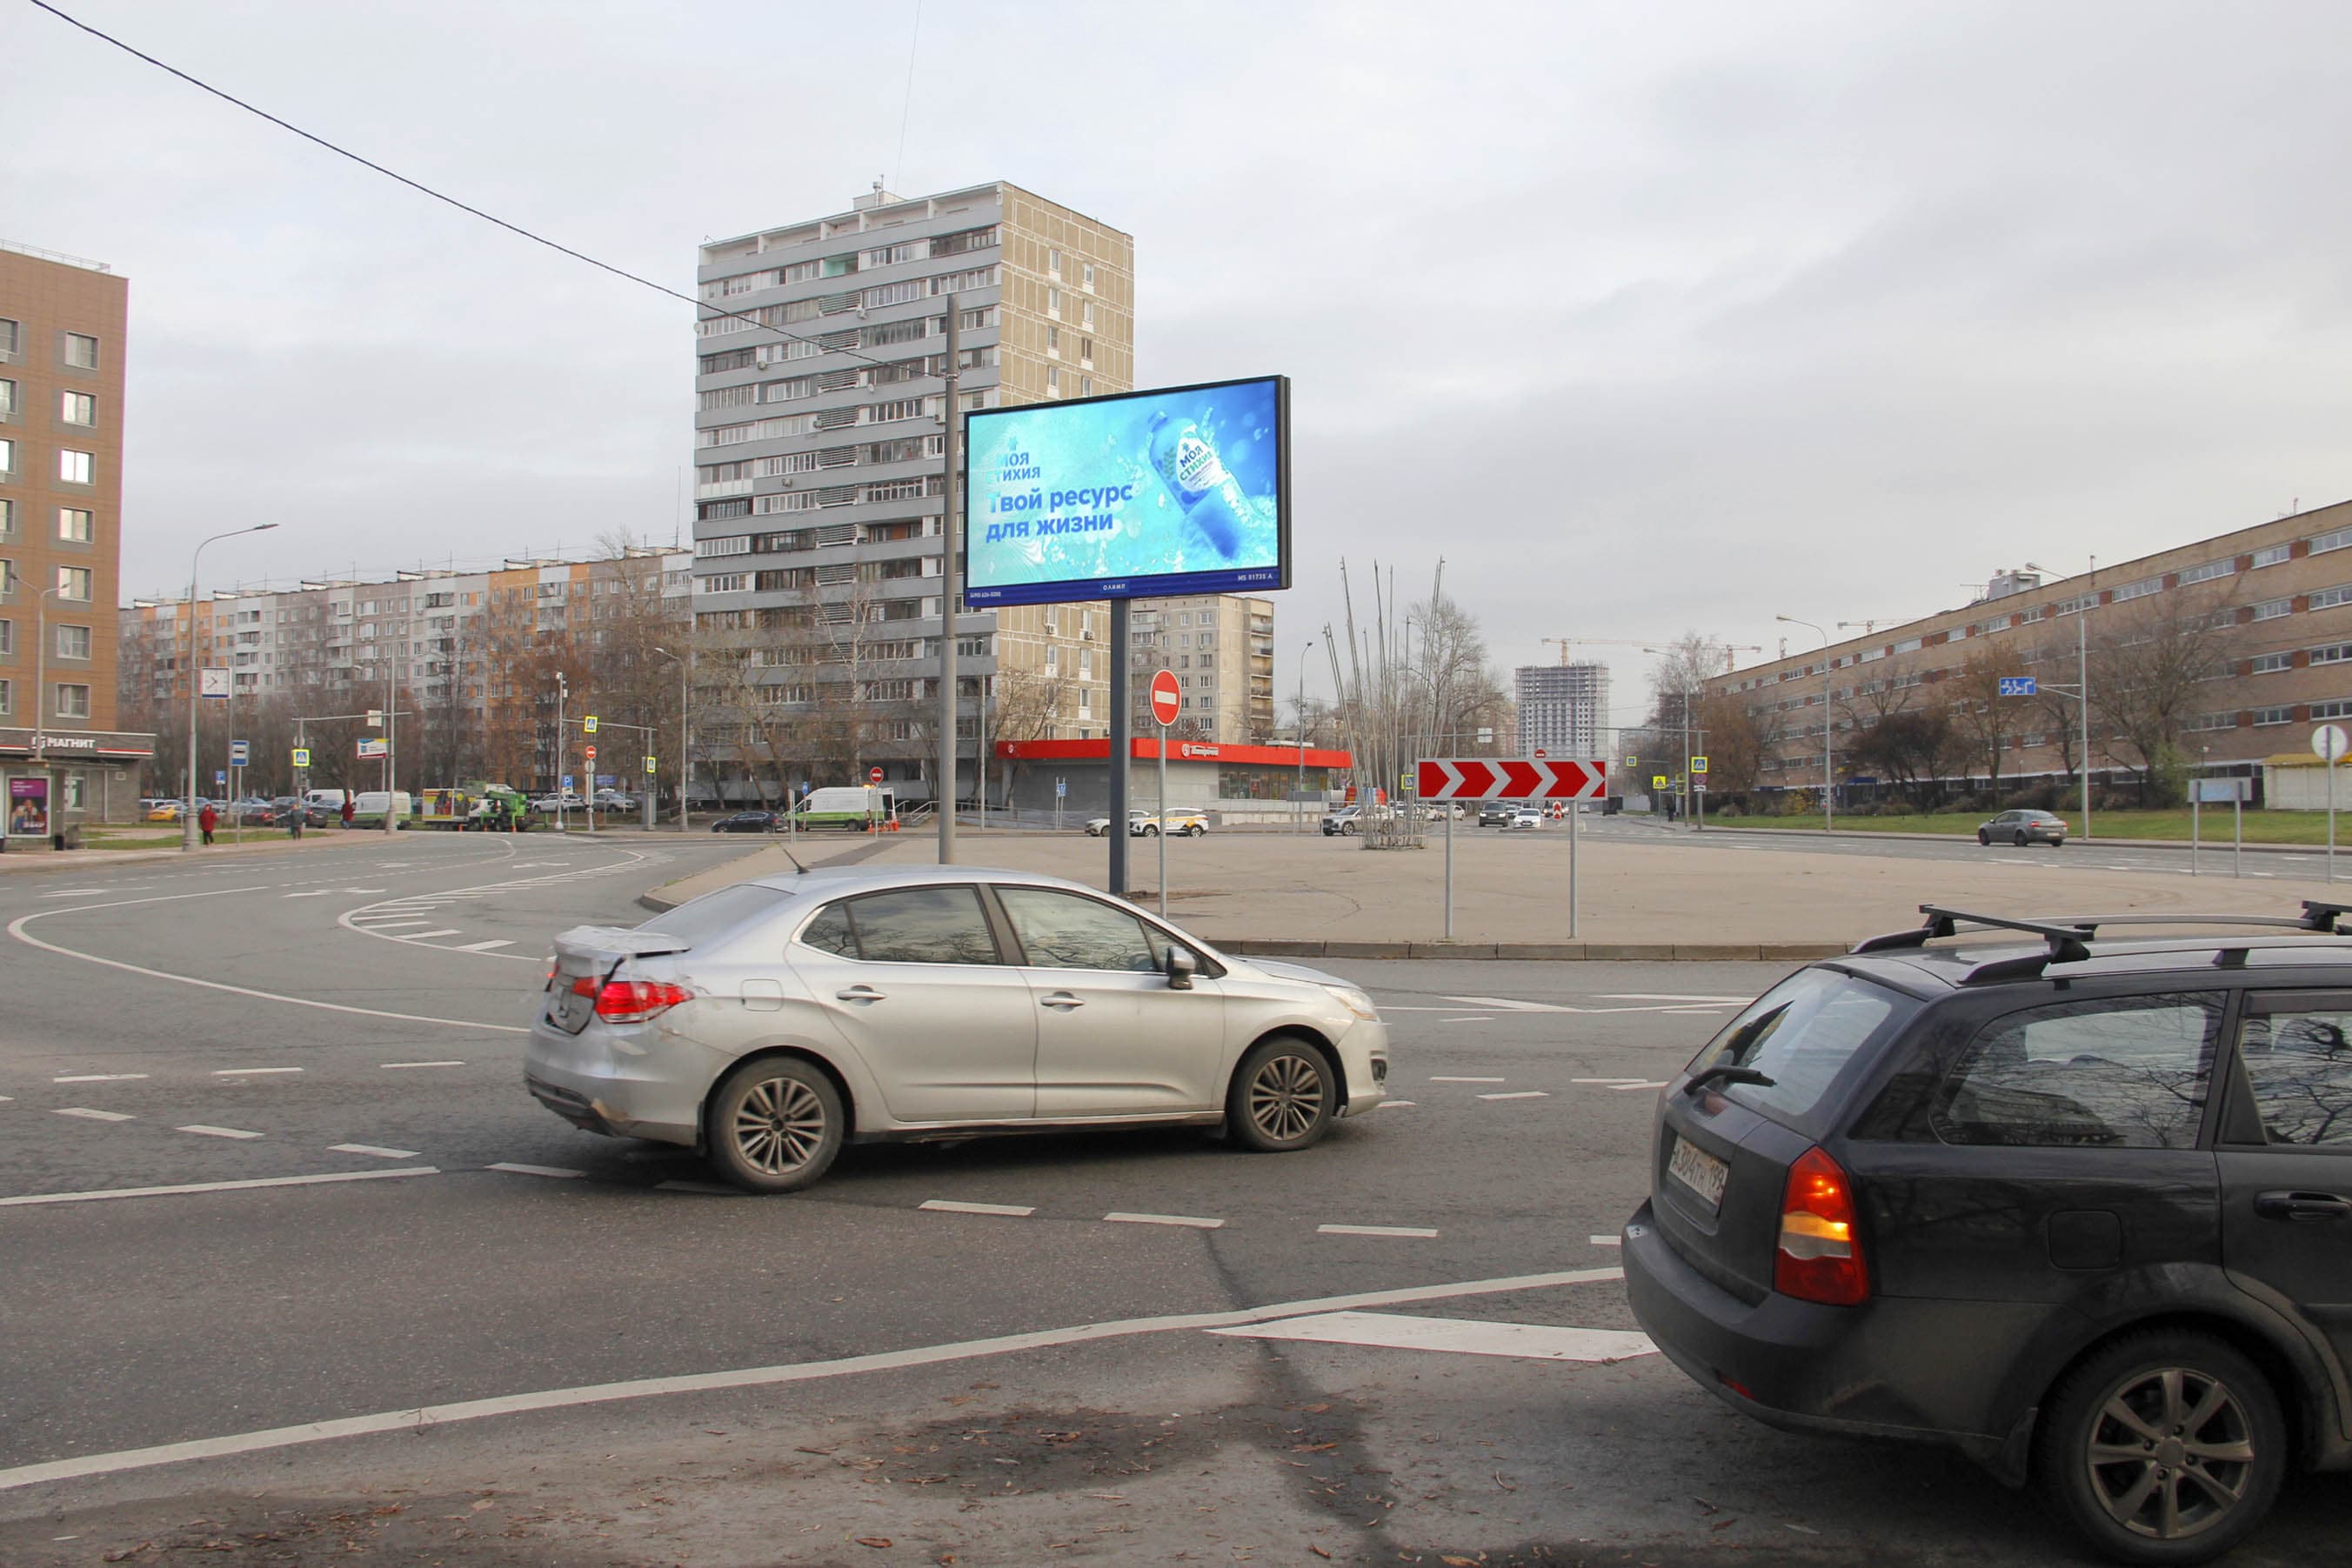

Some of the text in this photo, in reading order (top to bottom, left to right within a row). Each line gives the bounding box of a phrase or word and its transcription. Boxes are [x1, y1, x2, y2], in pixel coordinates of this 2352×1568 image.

[1179, 445, 1203, 468] МОЯ
[987, 484, 1133, 513] Твой ресурс
[986, 513, 1113, 544] для жизни
[46, 737, 96, 749] МАГНИТ
